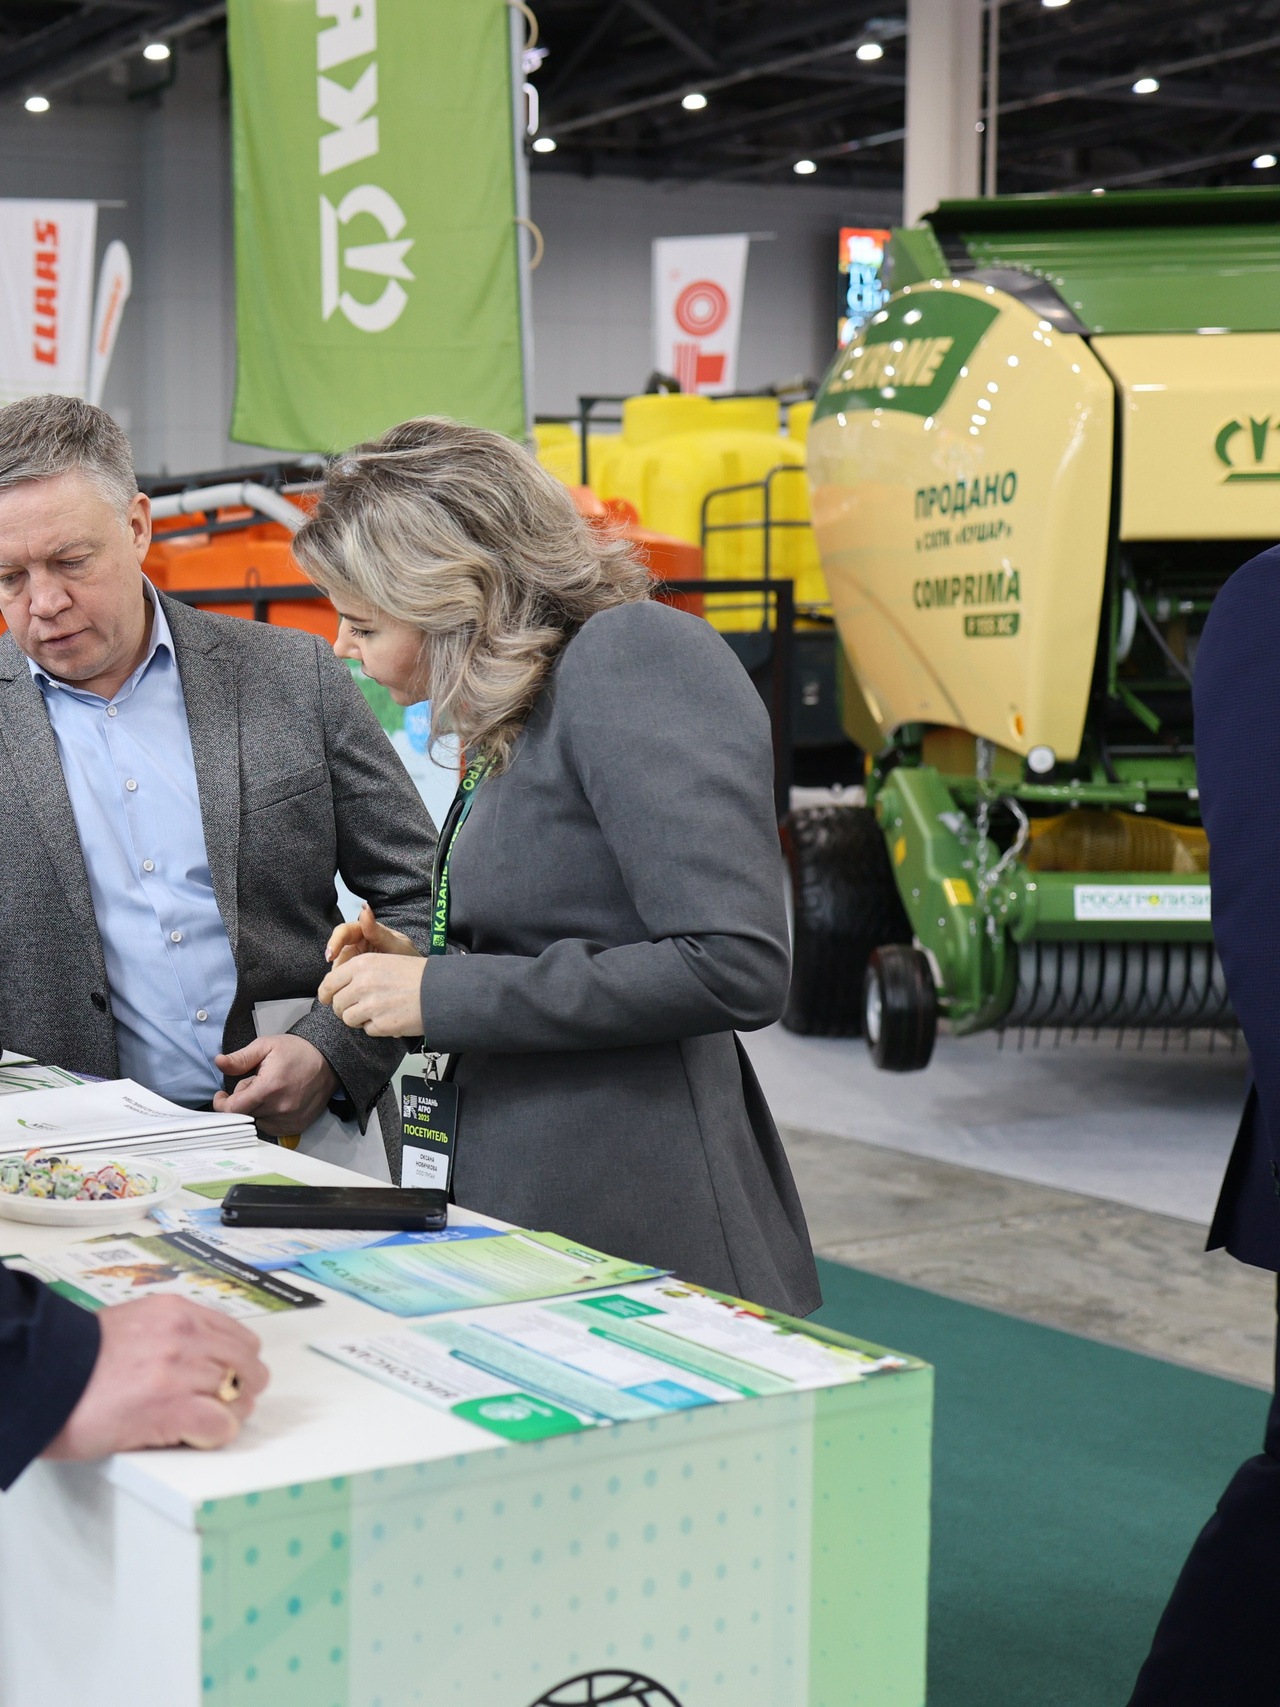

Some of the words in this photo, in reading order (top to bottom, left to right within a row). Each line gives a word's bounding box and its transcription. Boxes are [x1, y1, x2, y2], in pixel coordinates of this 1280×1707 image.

[32, 218, 59, 367] CLAAS
[915, 471, 1017, 520] ПРОДАНО
[913, 571, 1020, 610] COMPRIMA
[418, 1096, 438, 1107] КАЗАНЬ
[418, 1105, 431, 1114] АГРО
[418, 1113, 430, 1122] 2025
[403, 1123, 448, 1144] ПОСЕТИТЕЛЬ
